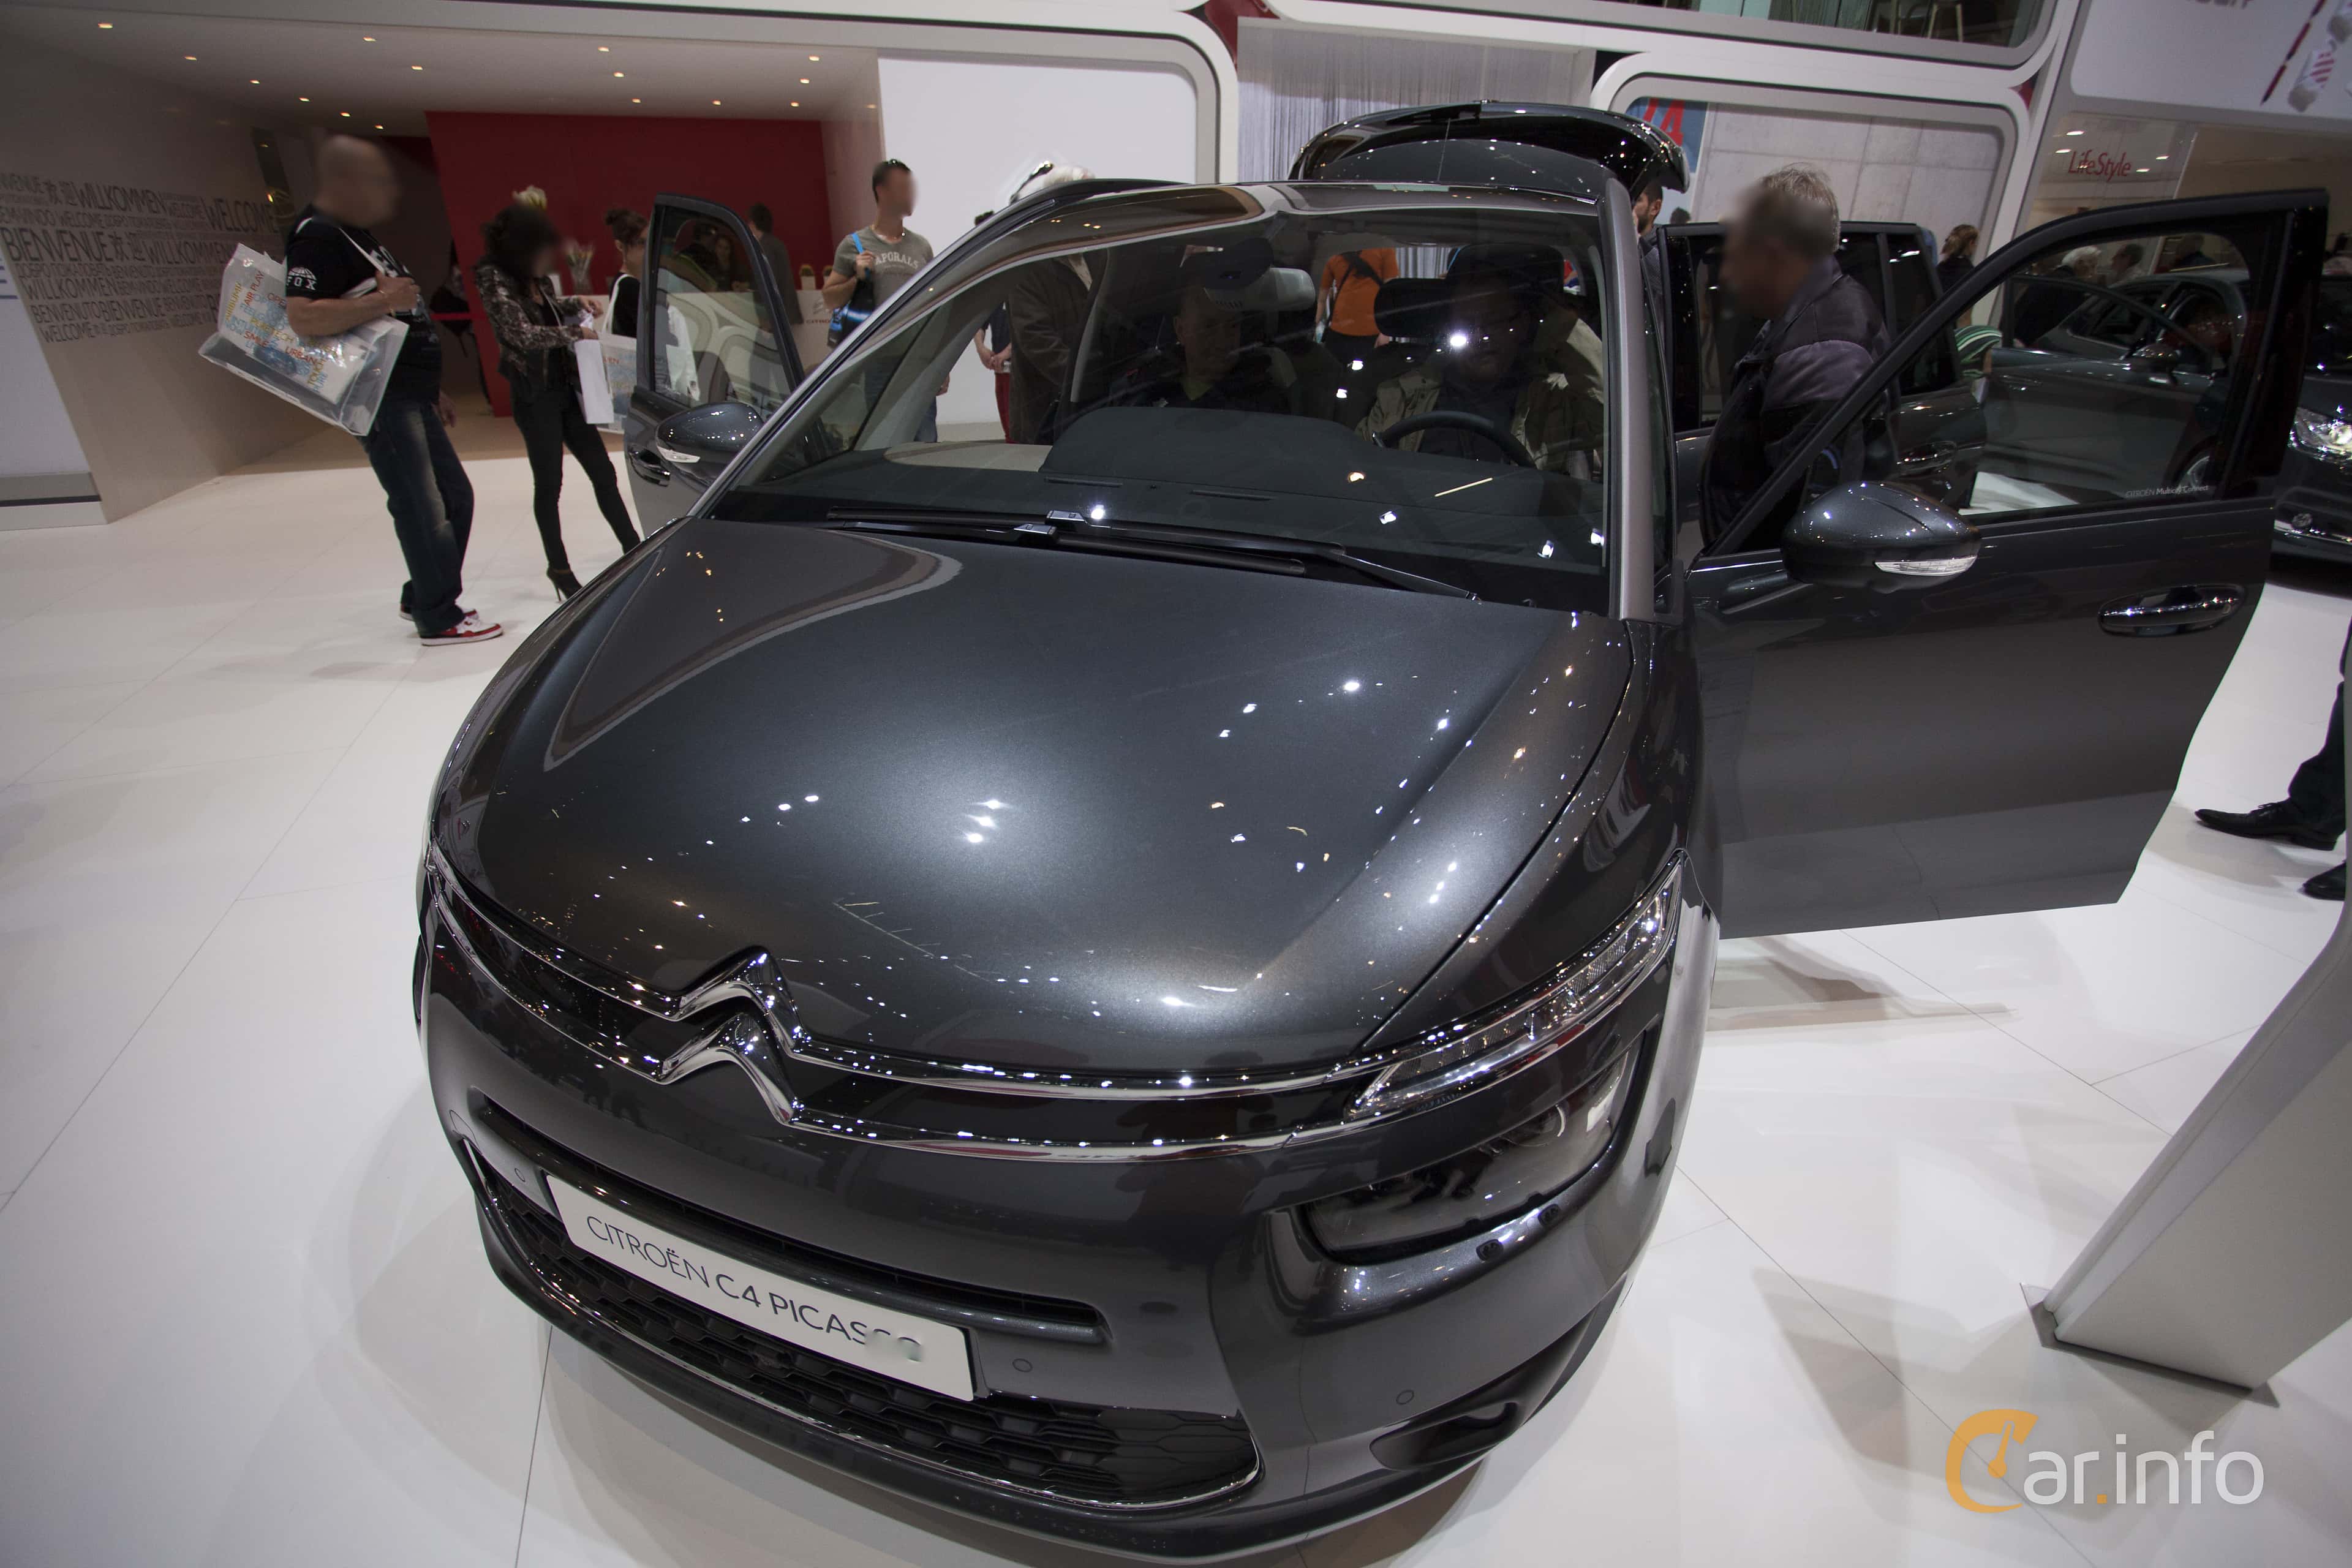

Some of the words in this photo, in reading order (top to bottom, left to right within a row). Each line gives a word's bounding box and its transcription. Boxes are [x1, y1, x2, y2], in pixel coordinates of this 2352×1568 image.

[2068, 149, 2132, 183] LifeStyle
[72, 182, 167, 216] WILLKOMMEN
[199, 195, 281, 233] WELCOME
[0, 227, 113, 262] BIENVENUE
[18, 277, 118, 301] WILLKOMMEN
[286, 276, 315, 290] FOX
[29, 301, 100, 323] BENVENUTO
[97, 297, 165, 322] BIENVENUE
[285, 344, 316, 365] URBAN
[587, 1216, 710, 1288] CITROËN
[716, 1273, 761, 1308] C4
[769, 1292, 924, 1363] PICAS
